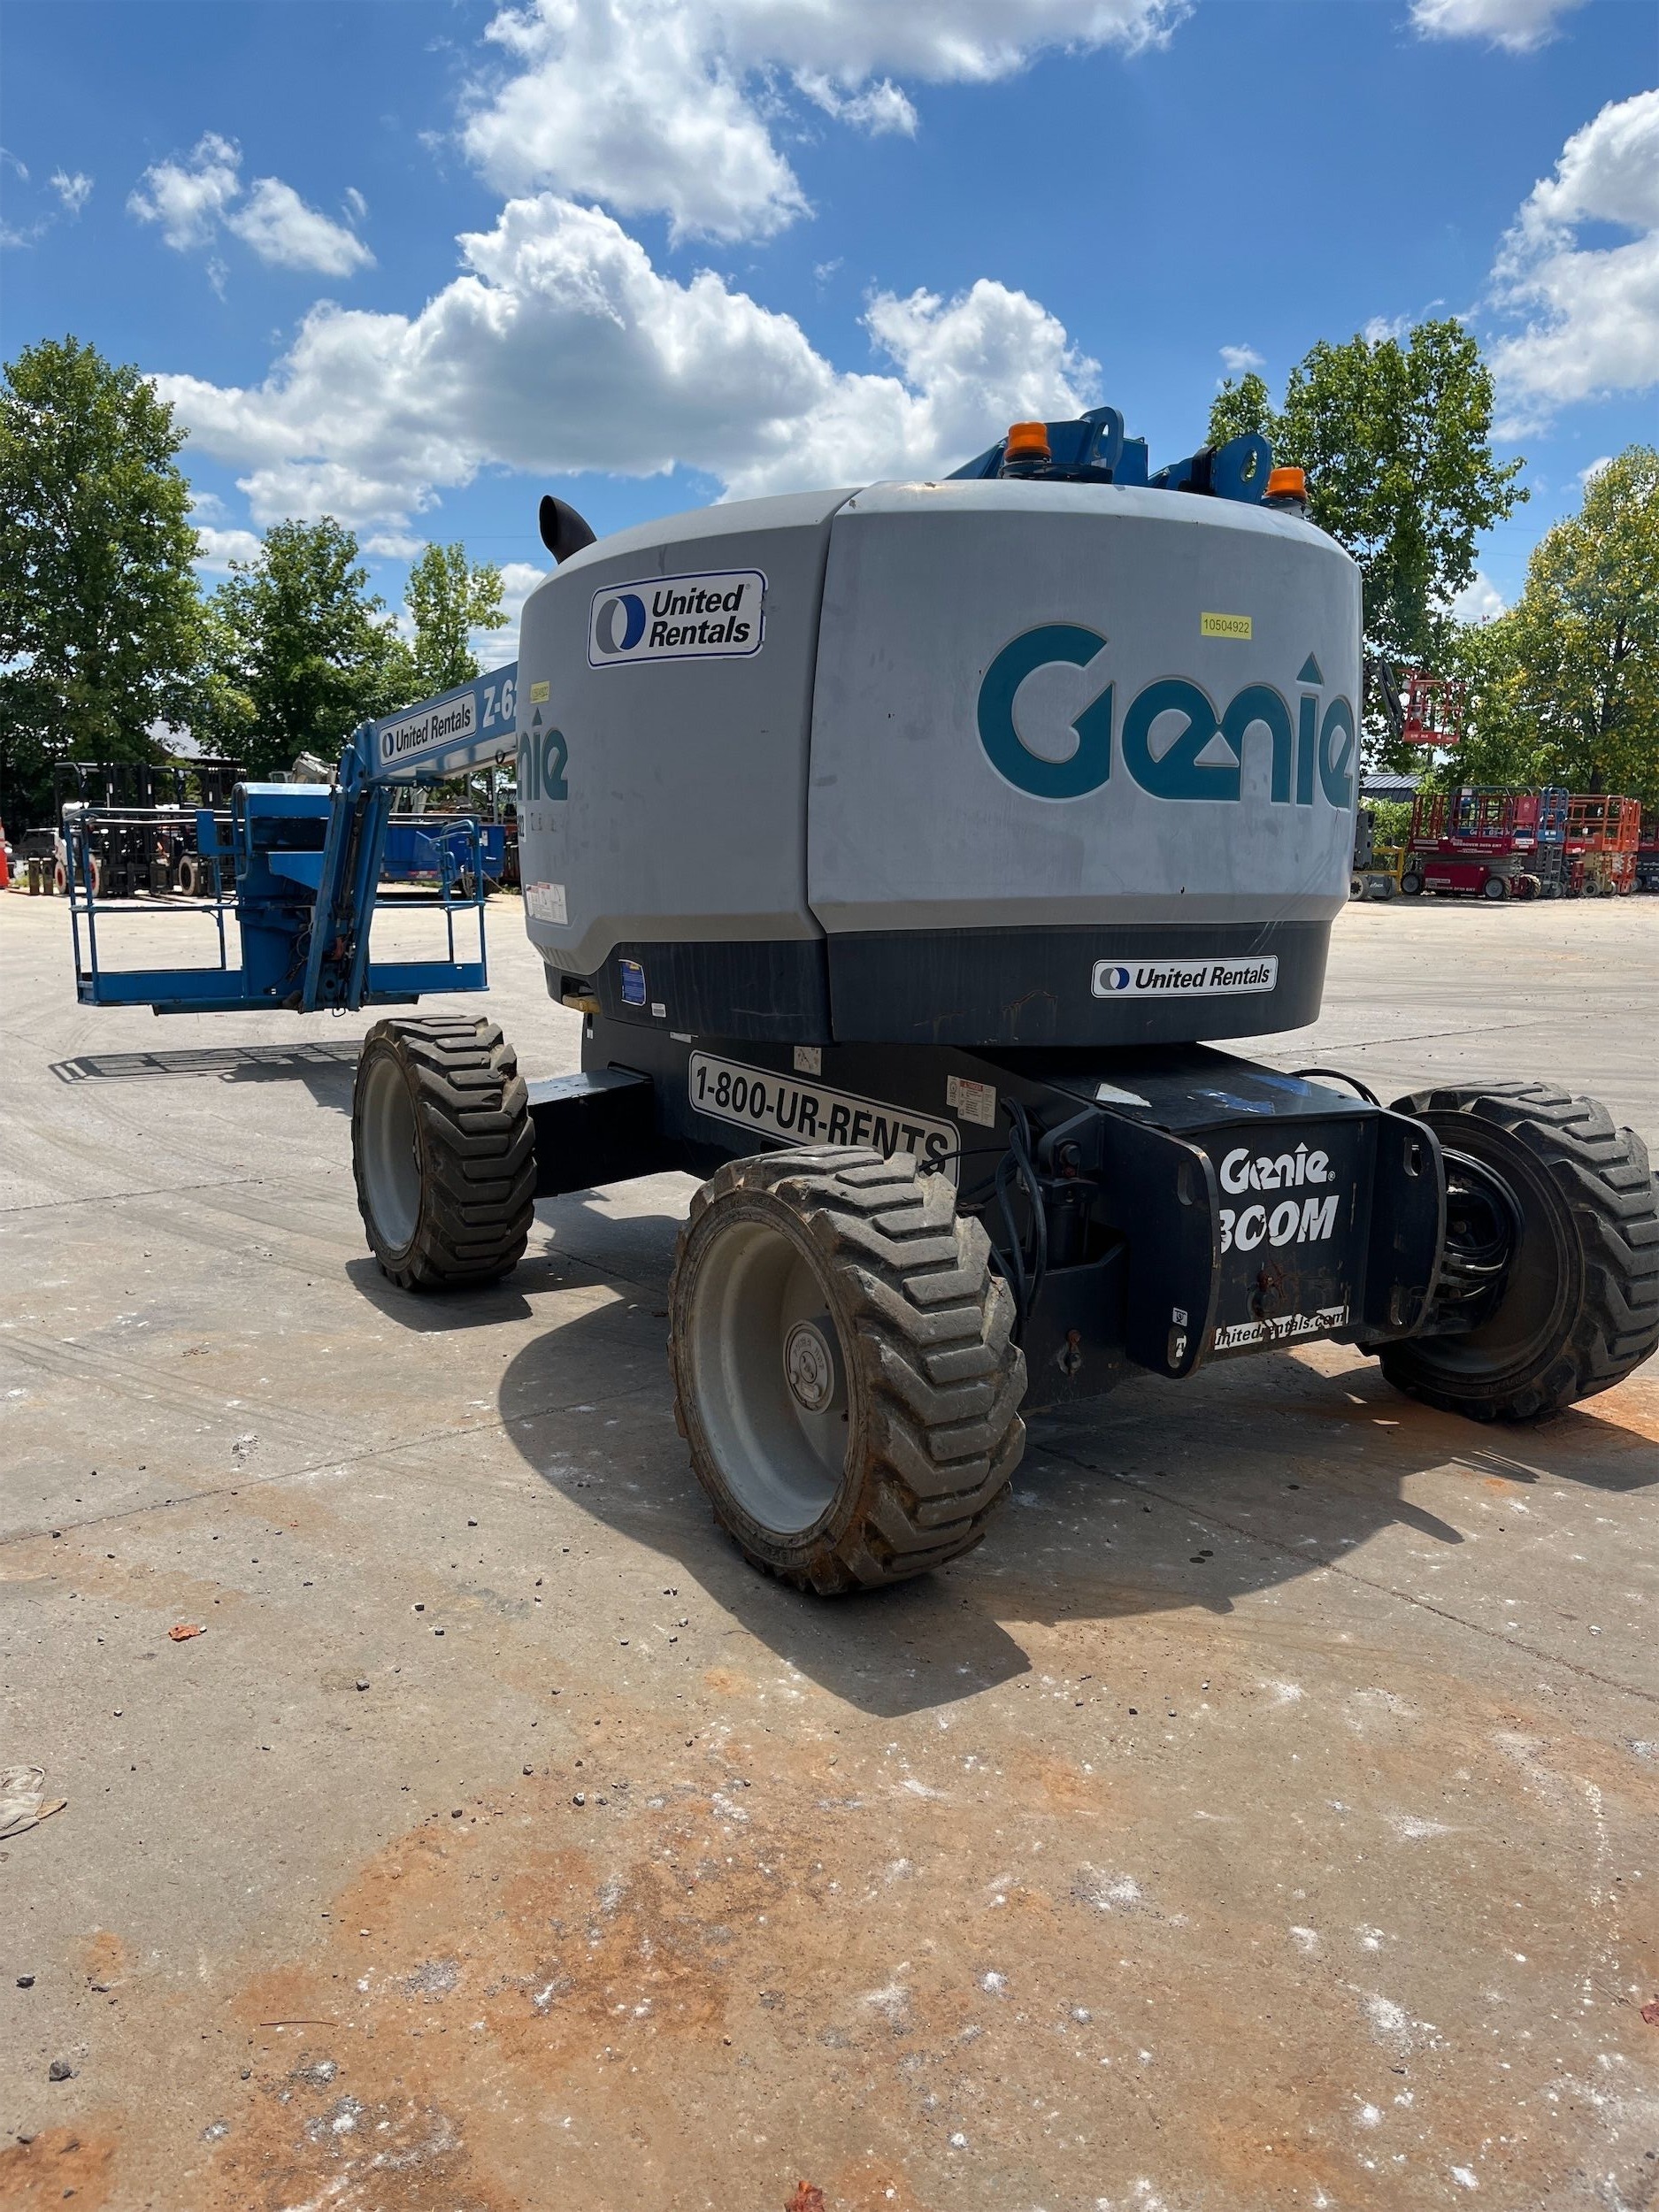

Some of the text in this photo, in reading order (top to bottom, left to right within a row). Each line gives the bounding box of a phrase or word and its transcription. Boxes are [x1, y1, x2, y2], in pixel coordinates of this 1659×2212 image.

[652, 584, 744, 617] United
[649, 616, 750, 648] Rentals
[1204, 618, 1249, 634] 10504922
[396, 704, 471, 751] United Rentals
[978, 624, 1354, 810] Genie
[518, 707, 568, 801] nie
[1135, 964, 1270, 988] United Rentals
[696, 1066, 949, 1175] 1-800-UR-RENTS
